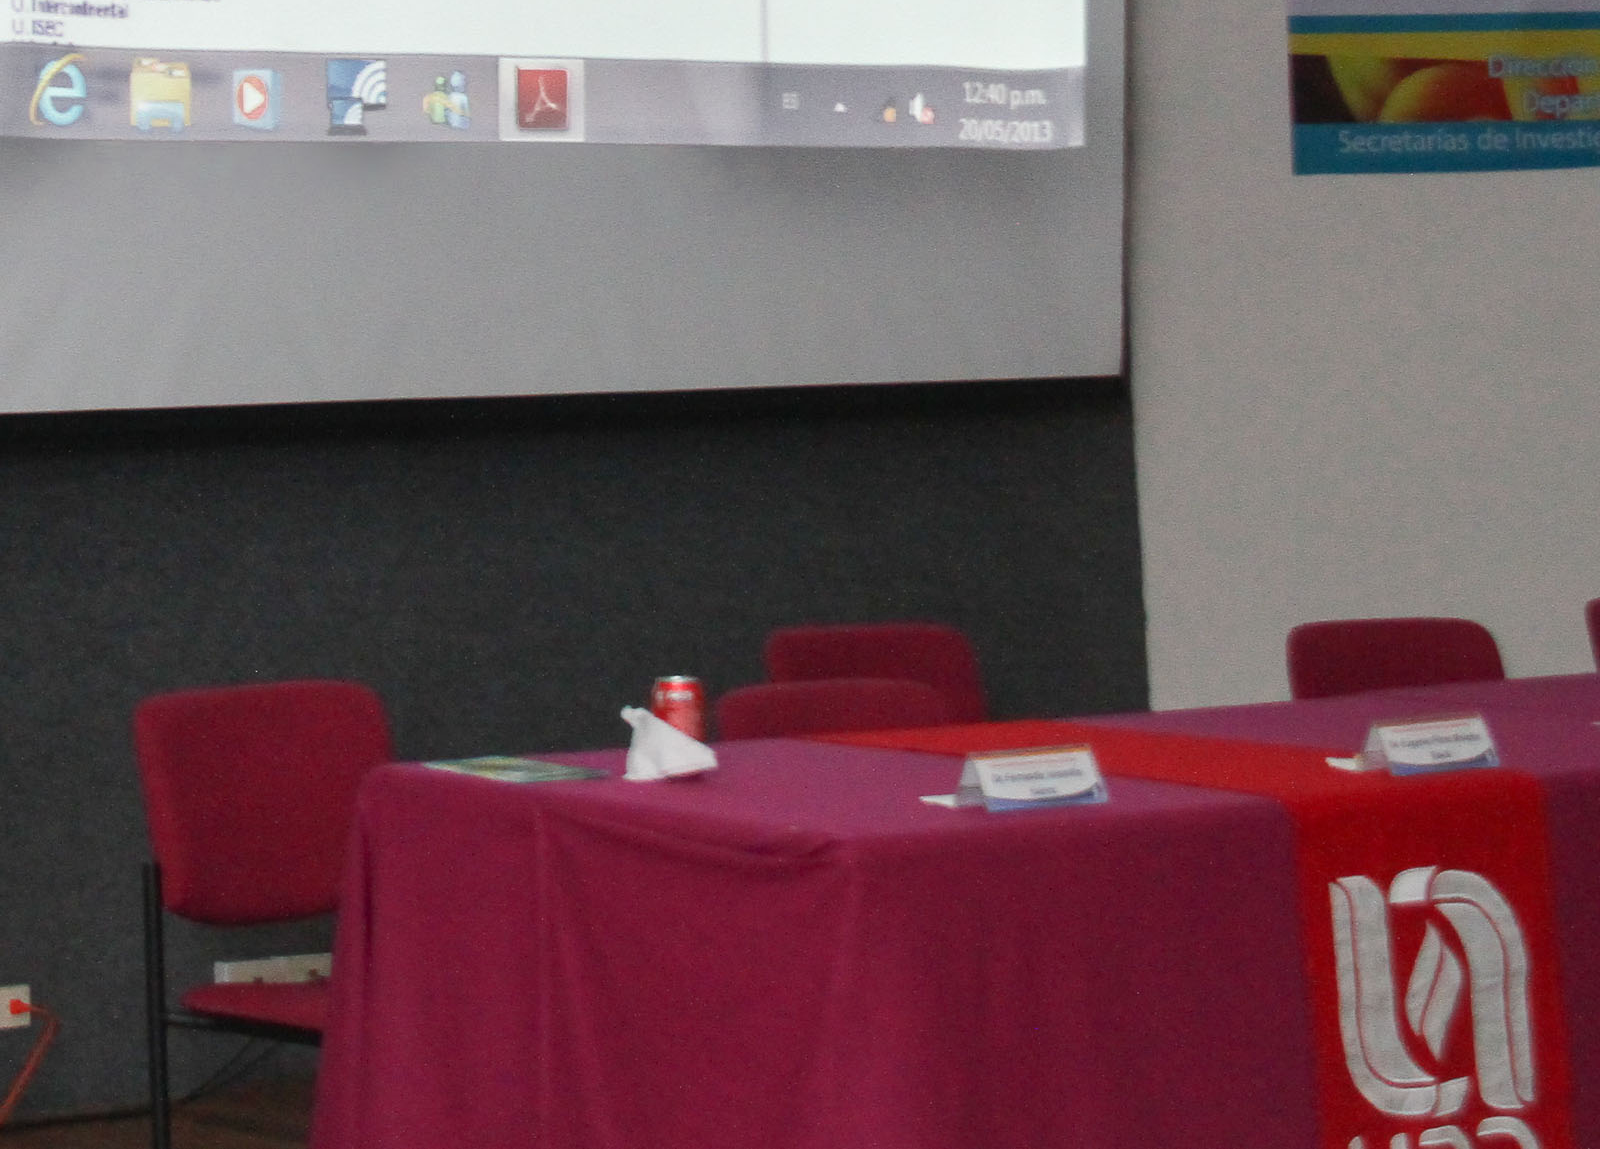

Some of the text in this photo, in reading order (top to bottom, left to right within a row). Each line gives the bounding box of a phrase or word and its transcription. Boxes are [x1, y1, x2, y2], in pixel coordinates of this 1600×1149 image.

[963, 81, 1007, 105] 12:40
[1338, 127, 1469, 152] Secretarías
[1478, 128, 1508, 150] de
